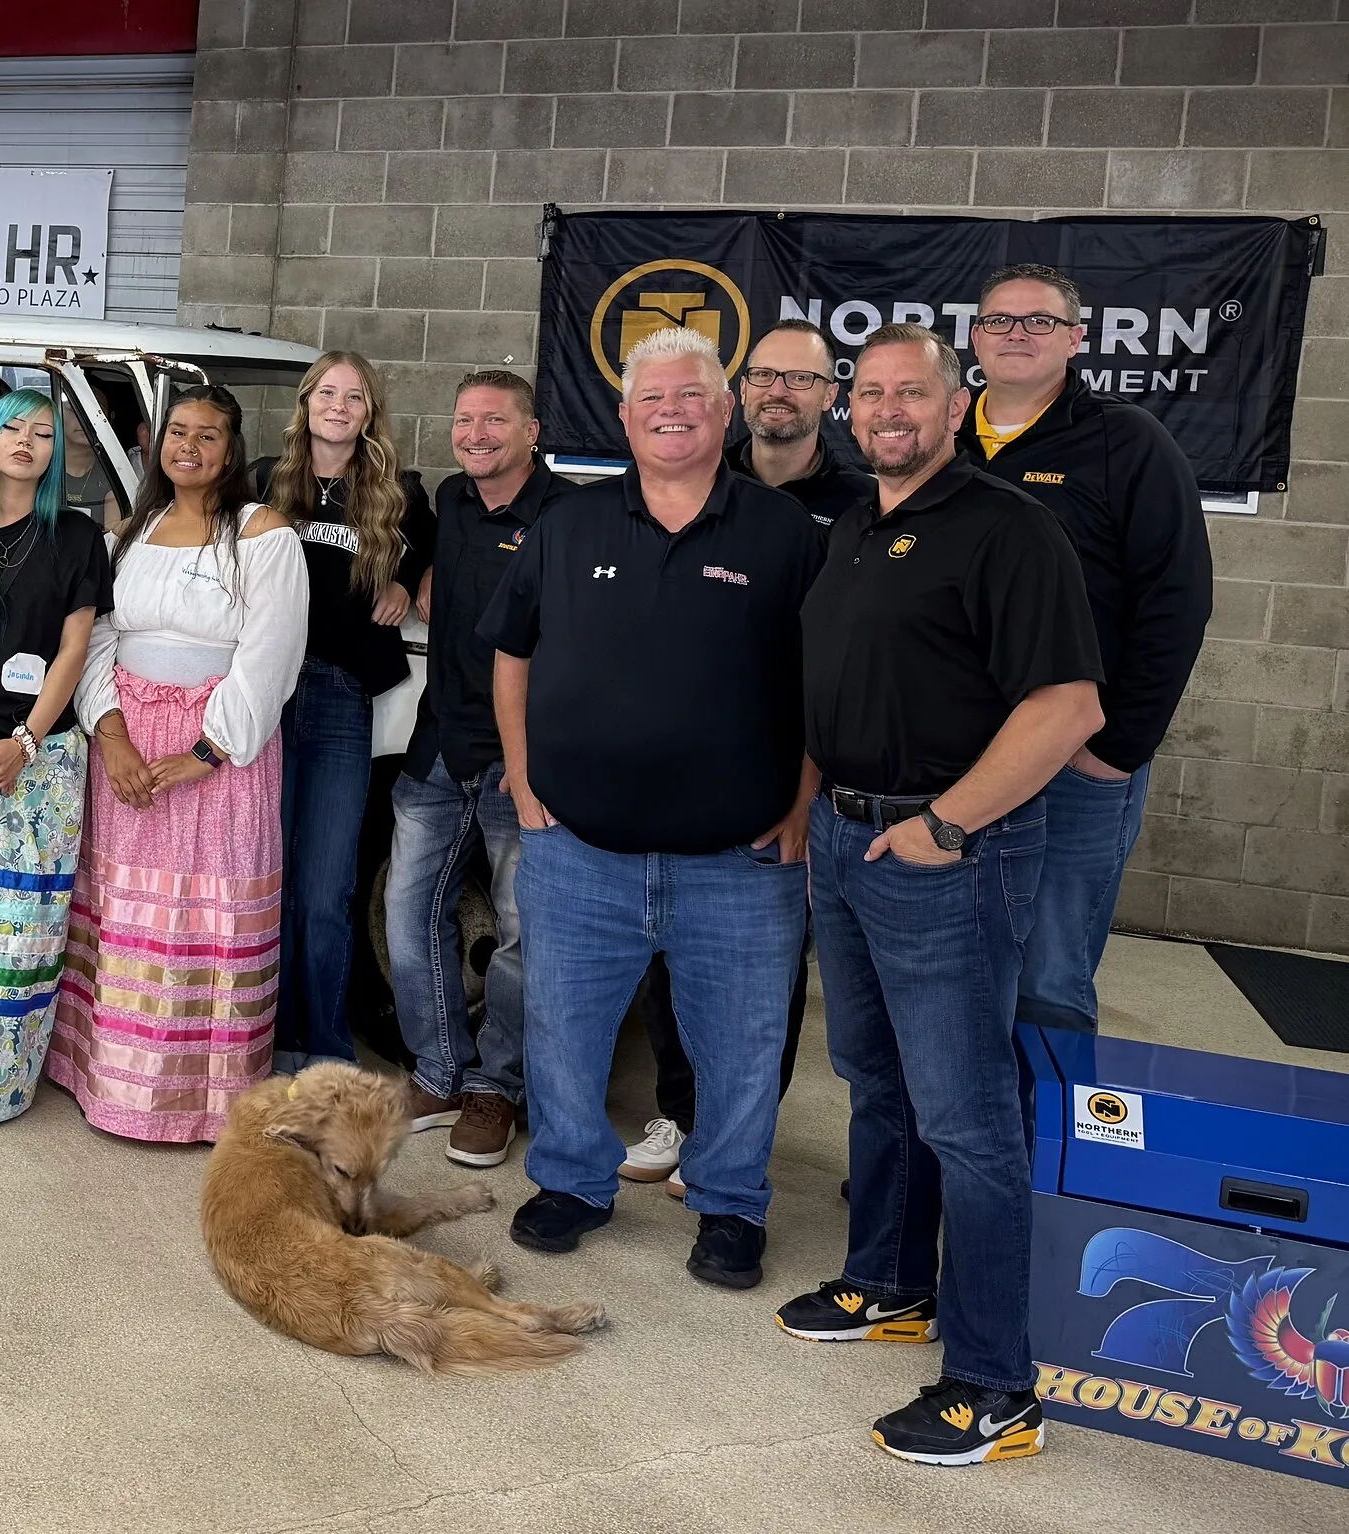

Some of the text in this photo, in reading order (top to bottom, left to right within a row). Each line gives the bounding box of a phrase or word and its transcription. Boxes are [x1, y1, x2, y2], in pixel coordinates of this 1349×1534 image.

[17, 288, 81, 308] PLAZA
[1032, 1360, 1242, 1439] HOUSE
[1278, 1418, 1349, 1469] K
